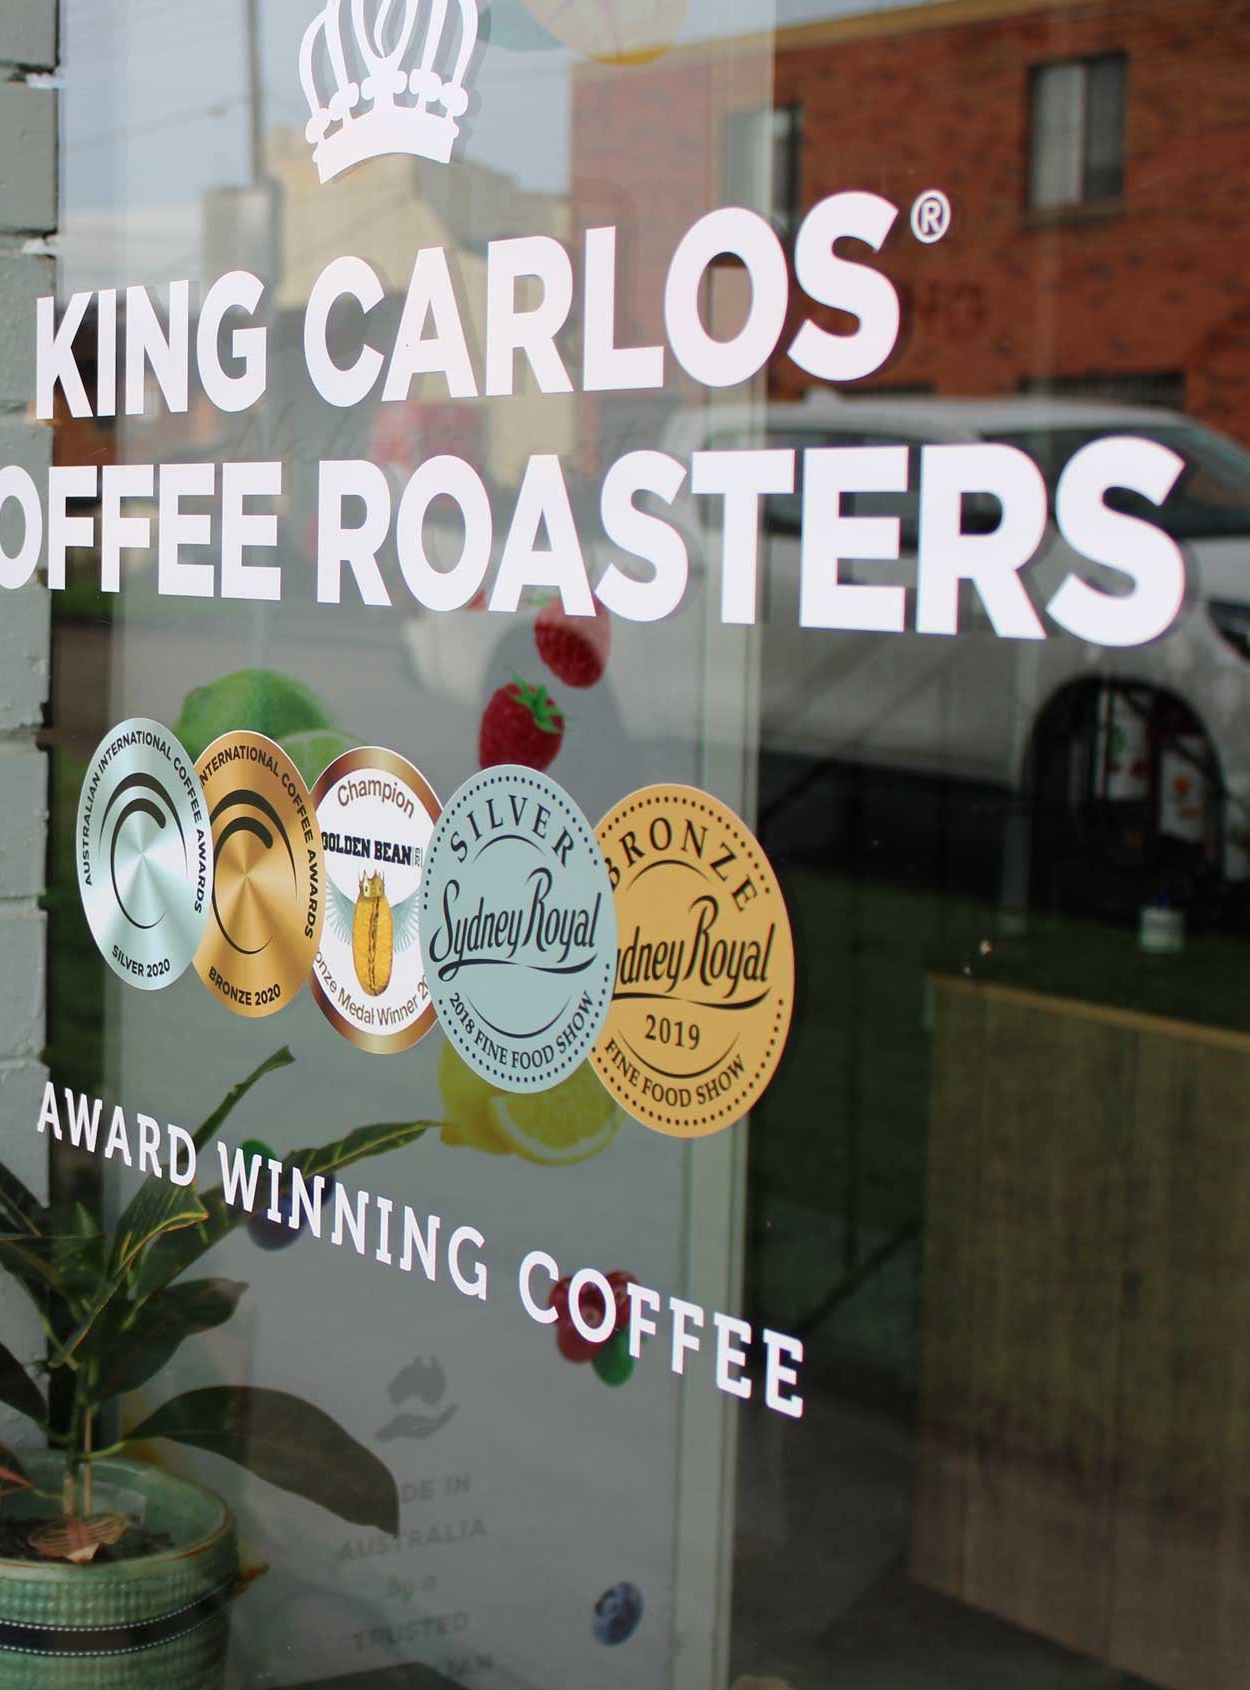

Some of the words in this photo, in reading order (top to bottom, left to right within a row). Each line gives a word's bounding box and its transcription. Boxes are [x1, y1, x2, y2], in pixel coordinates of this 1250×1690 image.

[35, 270, 268, 420] KING
[316, 436, 1187, 648] ROASTERS
[82, 772, 100, 886] AUSTRALIAN
[98, 730, 172, 775] INTERNATIONAL
[173, 757, 202, 823] COFFEE
[194, 828, 207, 914] AWARDS
[337, 778, 415, 819] Champion
[450, 794, 575, 868] SILVER
[200, 745, 279, 787] NTERNATIONAL
[281, 772, 314, 844] COFFEE
[304, 848, 319, 939] AWARDS
[374, 840, 412, 866] BEAN
[604, 816, 759, 912] BRONZE
[112, 944, 145, 977] SILVER
[146, 958, 171, 978] 2020
[429, 878, 523, 982] Sydney
[521, 866, 602, 964] Royal
[614, 925, 685, 993] dney
[684, 894, 776, 999] Royal
[208, 965, 252, 1006] BRONZE
[255, 983, 281, 1006] 2020
[314, 950, 338, 993] onze
[338, 987, 375, 1026] Medal
[376, 996, 418, 1026] Winner
[449, 992, 476, 1035] 2018
[474, 1028, 509, 1067] FINE
[512, 1044, 555, 1071] FOOD
[555, 990, 595, 1054] SHOW
[644, 1013, 701, 1051] 2019
[604, 1037, 641, 1087] FINE
[641, 1075, 692, 1108] FOOD
[696, 1053, 746, 1105] SHOW
[36, 1080, 198, 1187] AWARD
[217, 1140, 488, 1301] WINNING
[518, 1250, 804, 1419] COFFEE
[401, 1479, 436, 1505] DE
[334, 1516, 488, 1562] AUSTRALIA
